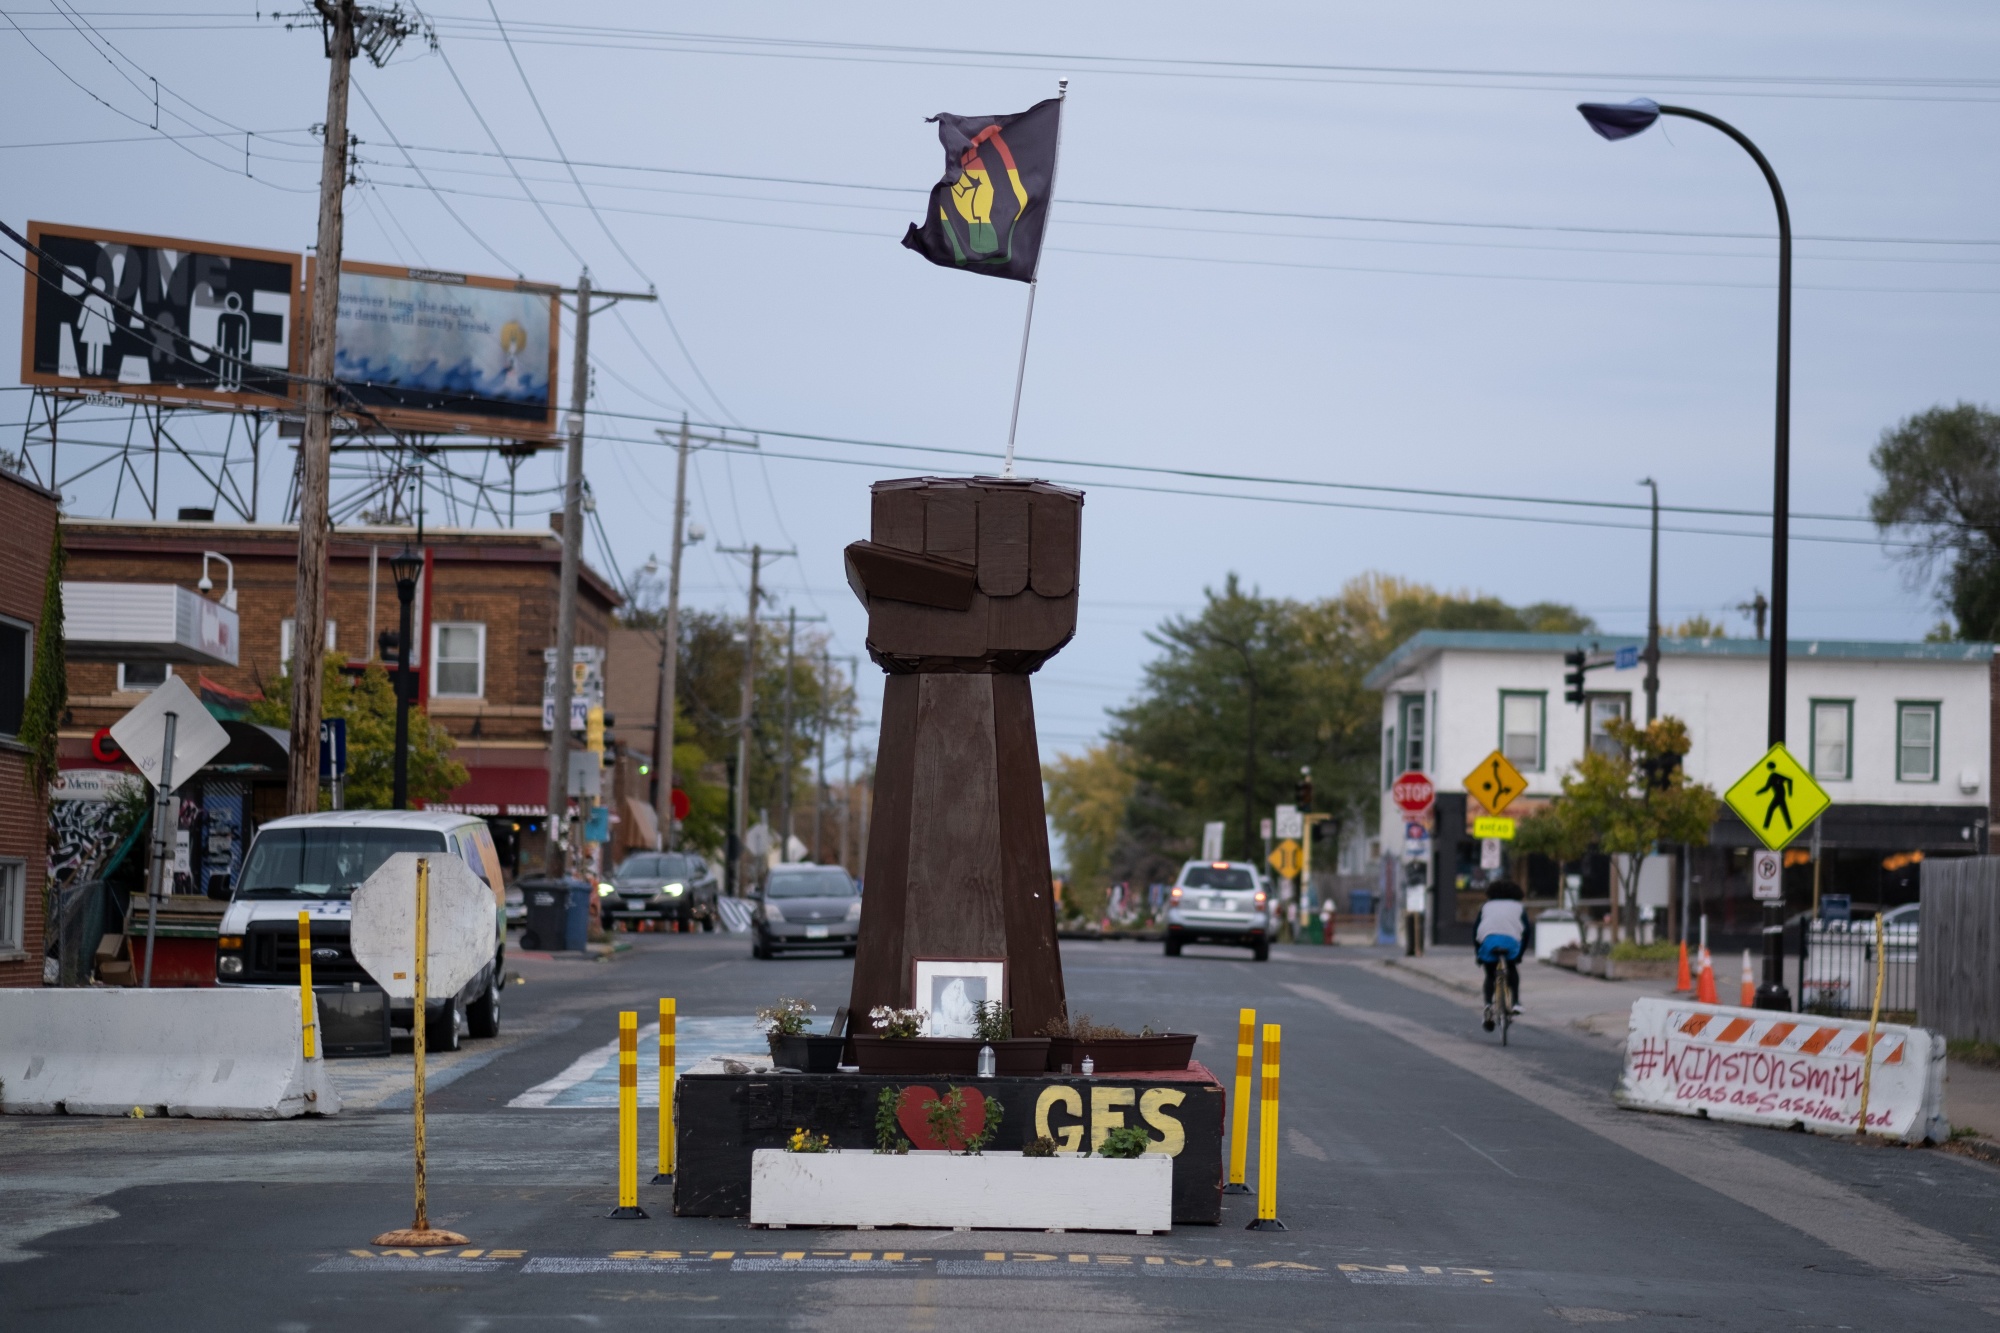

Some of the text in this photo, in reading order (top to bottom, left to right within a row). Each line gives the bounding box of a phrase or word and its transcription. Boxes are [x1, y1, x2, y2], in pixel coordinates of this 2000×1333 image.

[389, 296, 414, 311] long
[418, 299, 437, 312] the
[338, 307, 351, 318] he
[355, 308, 388, 323] dawn
[391, 311, 414, 325] will
[417, 315, 453, 331] surely
[68, 778, 98, 790] Metro
[1394, 783, 1434, 802] STOP
[465, 804, 499, 816] FOOD
[507, 804, 548, 816] HALAL
[1479, 823, 1510, 834] AHEAD
[1677, 1082, 1727, 1102] was
[347, 1248, 529, 1259] WE
[983, 1251, 1495, 1276] DEMAND
